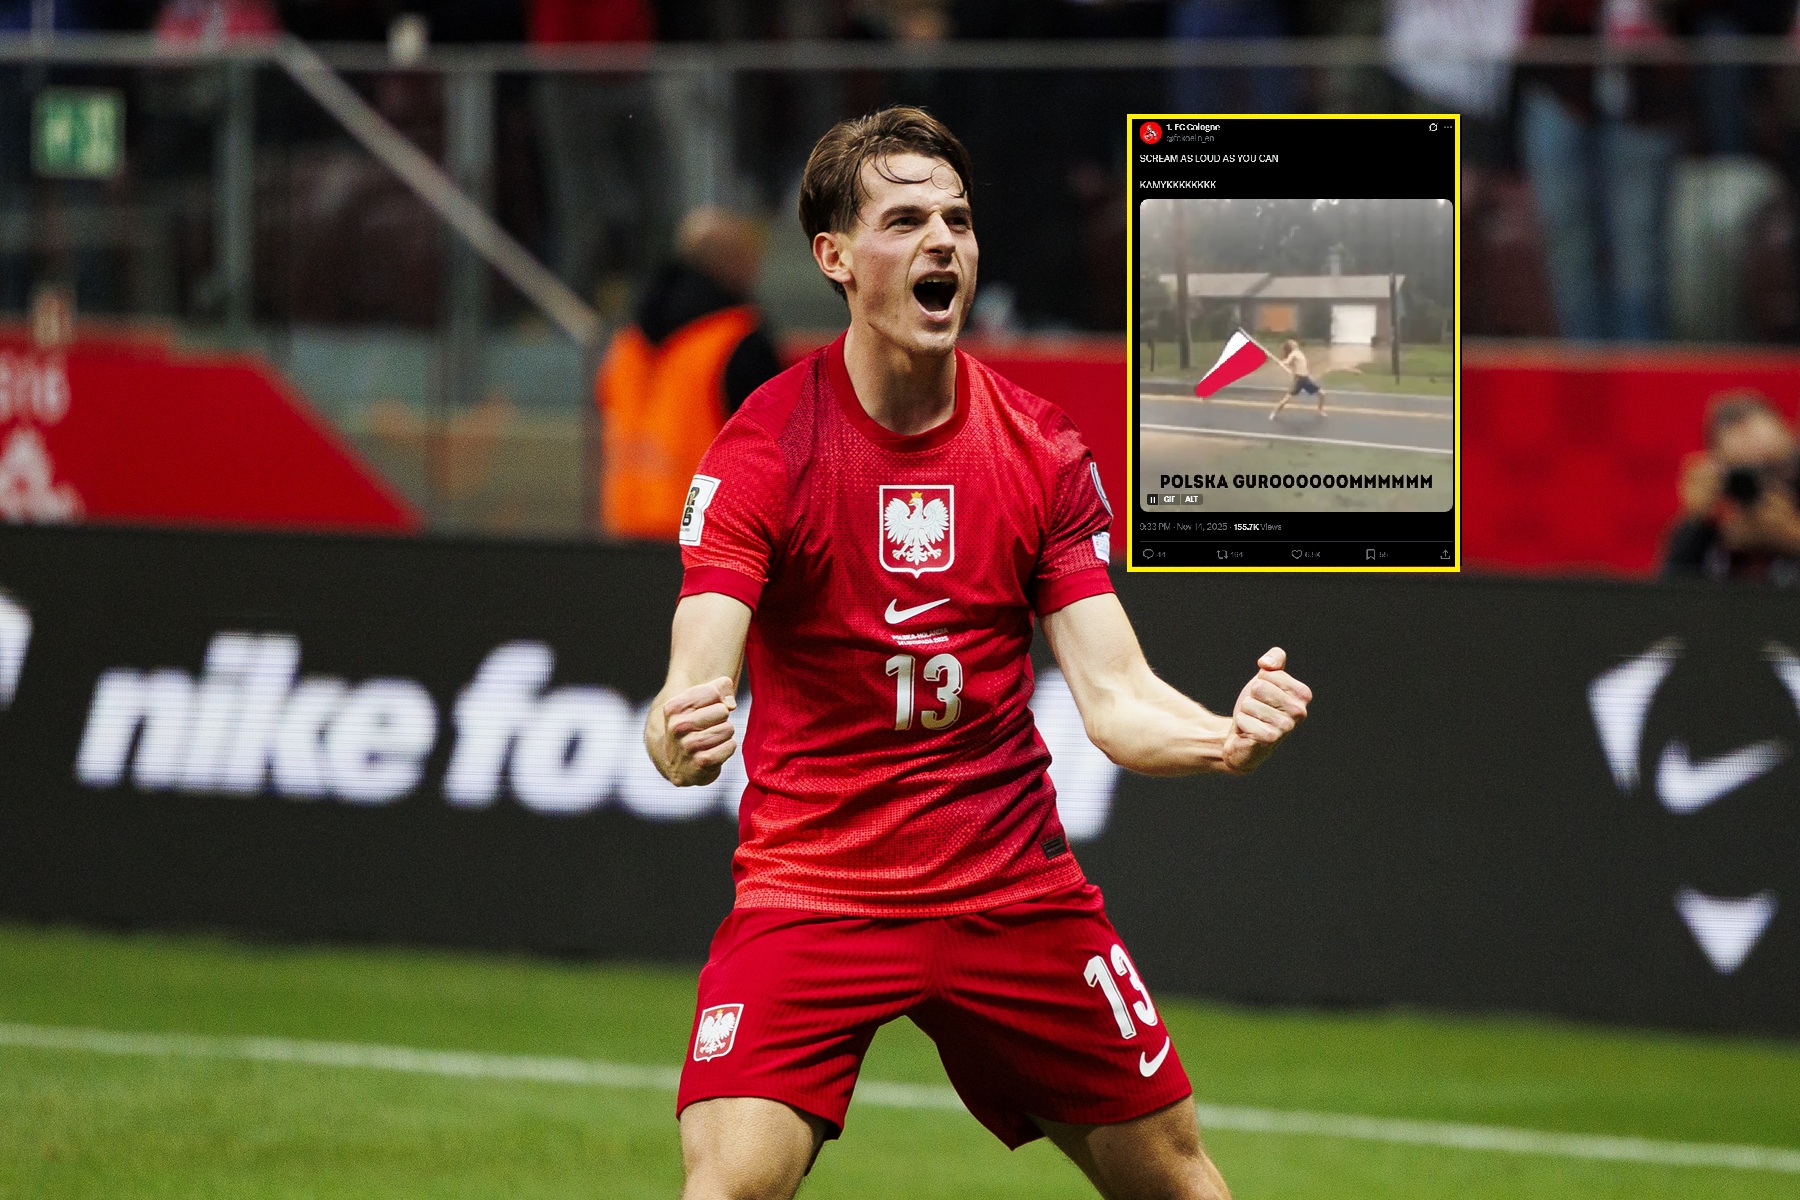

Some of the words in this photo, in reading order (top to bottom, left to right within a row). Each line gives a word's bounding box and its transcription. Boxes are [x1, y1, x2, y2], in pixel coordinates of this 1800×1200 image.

[77, 633, 437, 804] nike
[885, 652, 963, 731] 13
[1083, 943, 1158, 1040] 13
